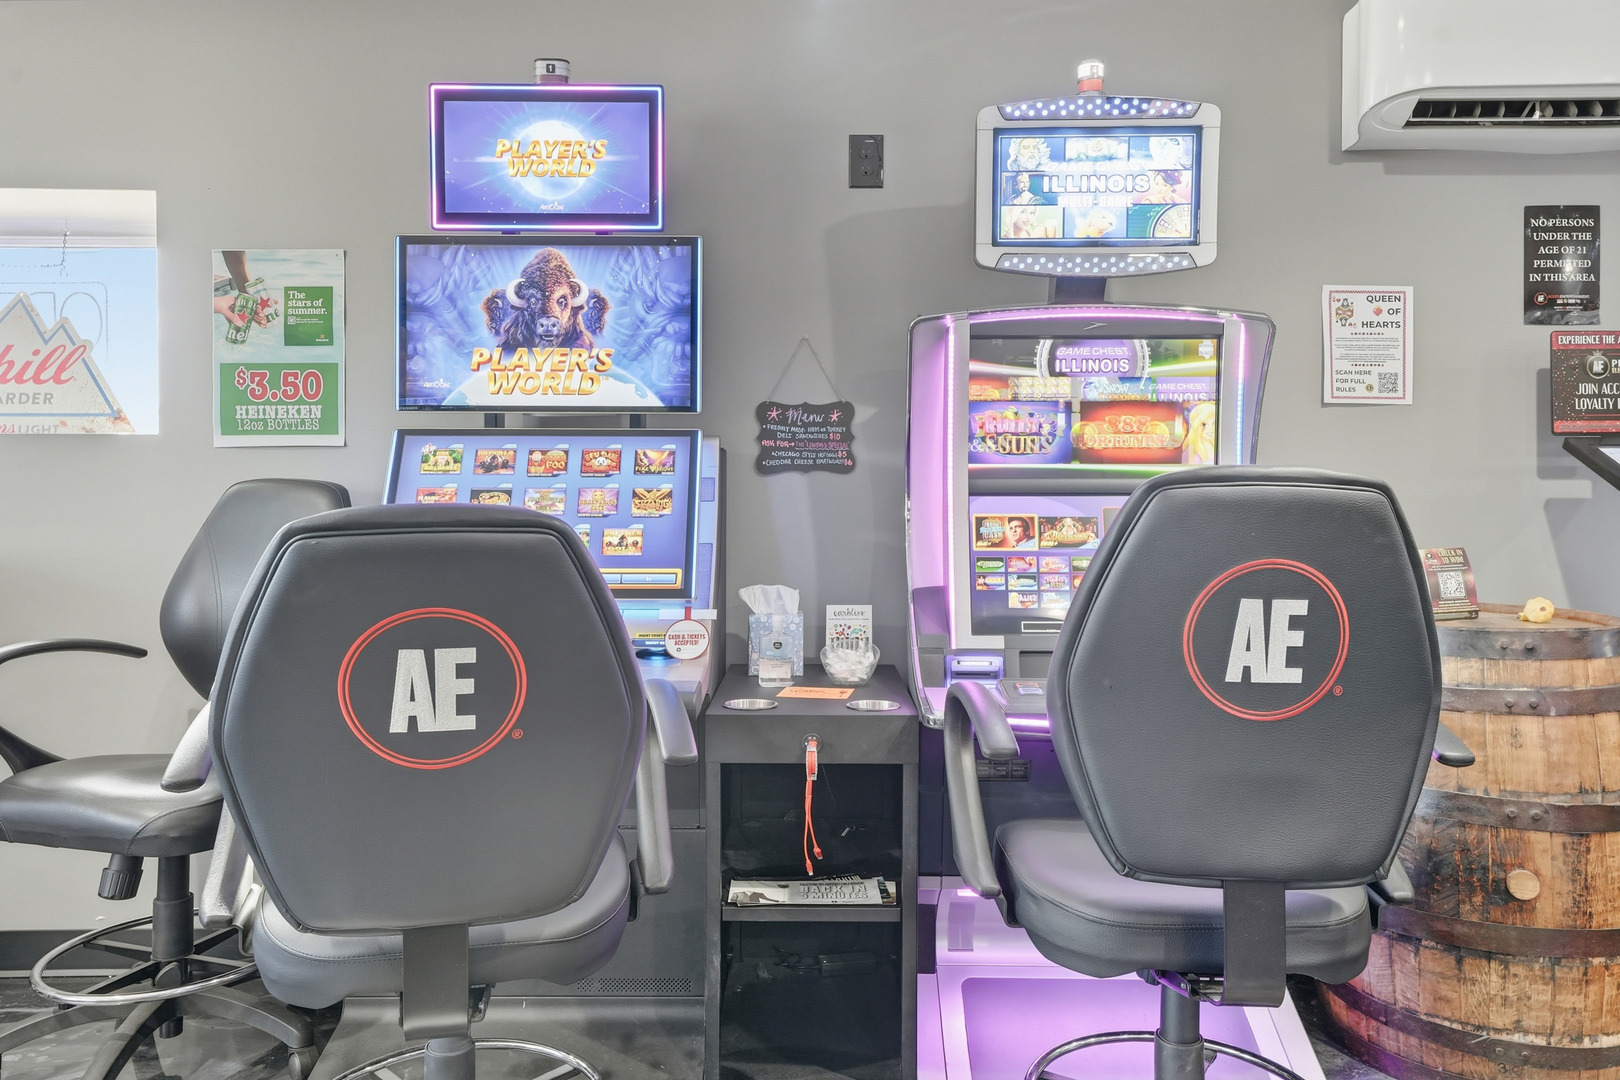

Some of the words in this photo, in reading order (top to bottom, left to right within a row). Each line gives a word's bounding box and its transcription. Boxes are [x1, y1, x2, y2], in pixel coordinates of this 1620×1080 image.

[495, 139, 608, 160] PLAYER'S
[508, 158, 596, 178] WORLD
[1042, 174, 1151, 193] ILLINOIS
[1531, 218, 1547, 227] NO
[1549, 218, 1595, 227] PERSONS
[1533, 232, 1570, 241] UNDER
[1571, 232, 1593, 240] THE
[1538, 246, 1560, 254] AGE
[1561, 246, 1575, 254] OF
[1577, 246, 1587, 254] 21
[1533, 259, 1592, 268] PERMITED
[1529, 273, 1541, 281] IN
[1543, 273, 1567, 281] THIS
[1569, 273, 1596, 281] AREA
[287, 290, 306, 299] The
[1366, 294, 1402, 304] QUEEN
[313, 298, 323, 307] of
[287, 307, 328, 315] summer.
[1387, 308, 1402, 316] OF
[1361, 321, 1401, 329] HEARTS
[1558, 335, 1600, 345] EXPERIENCE
[1602, 335, 1616, 344] THE
[1056, 347, 1091, 356] GAME
[470, 347, 616, 373] PLAYER'S
[1054, 358, 1131, 374] ILLINOIS
[1592, 360, 1604, 374] AE
[235, 366, 323, 402] $3.50
[487, 371, 602, 396] WORLD
[1576, 383, 1598, 395] JOIN
[1575, 398, 1615, 410] LOYALTY
[235, 405, 322, 419] HEINEKEN
[785, 407, 825, 425] Menu
[237, 420, 264, 431] 12oz
[267, 419, 320, 431] BOTTLES
[1225, 598, 1309, 684] AE
[389, 647, 477, 733] AE
